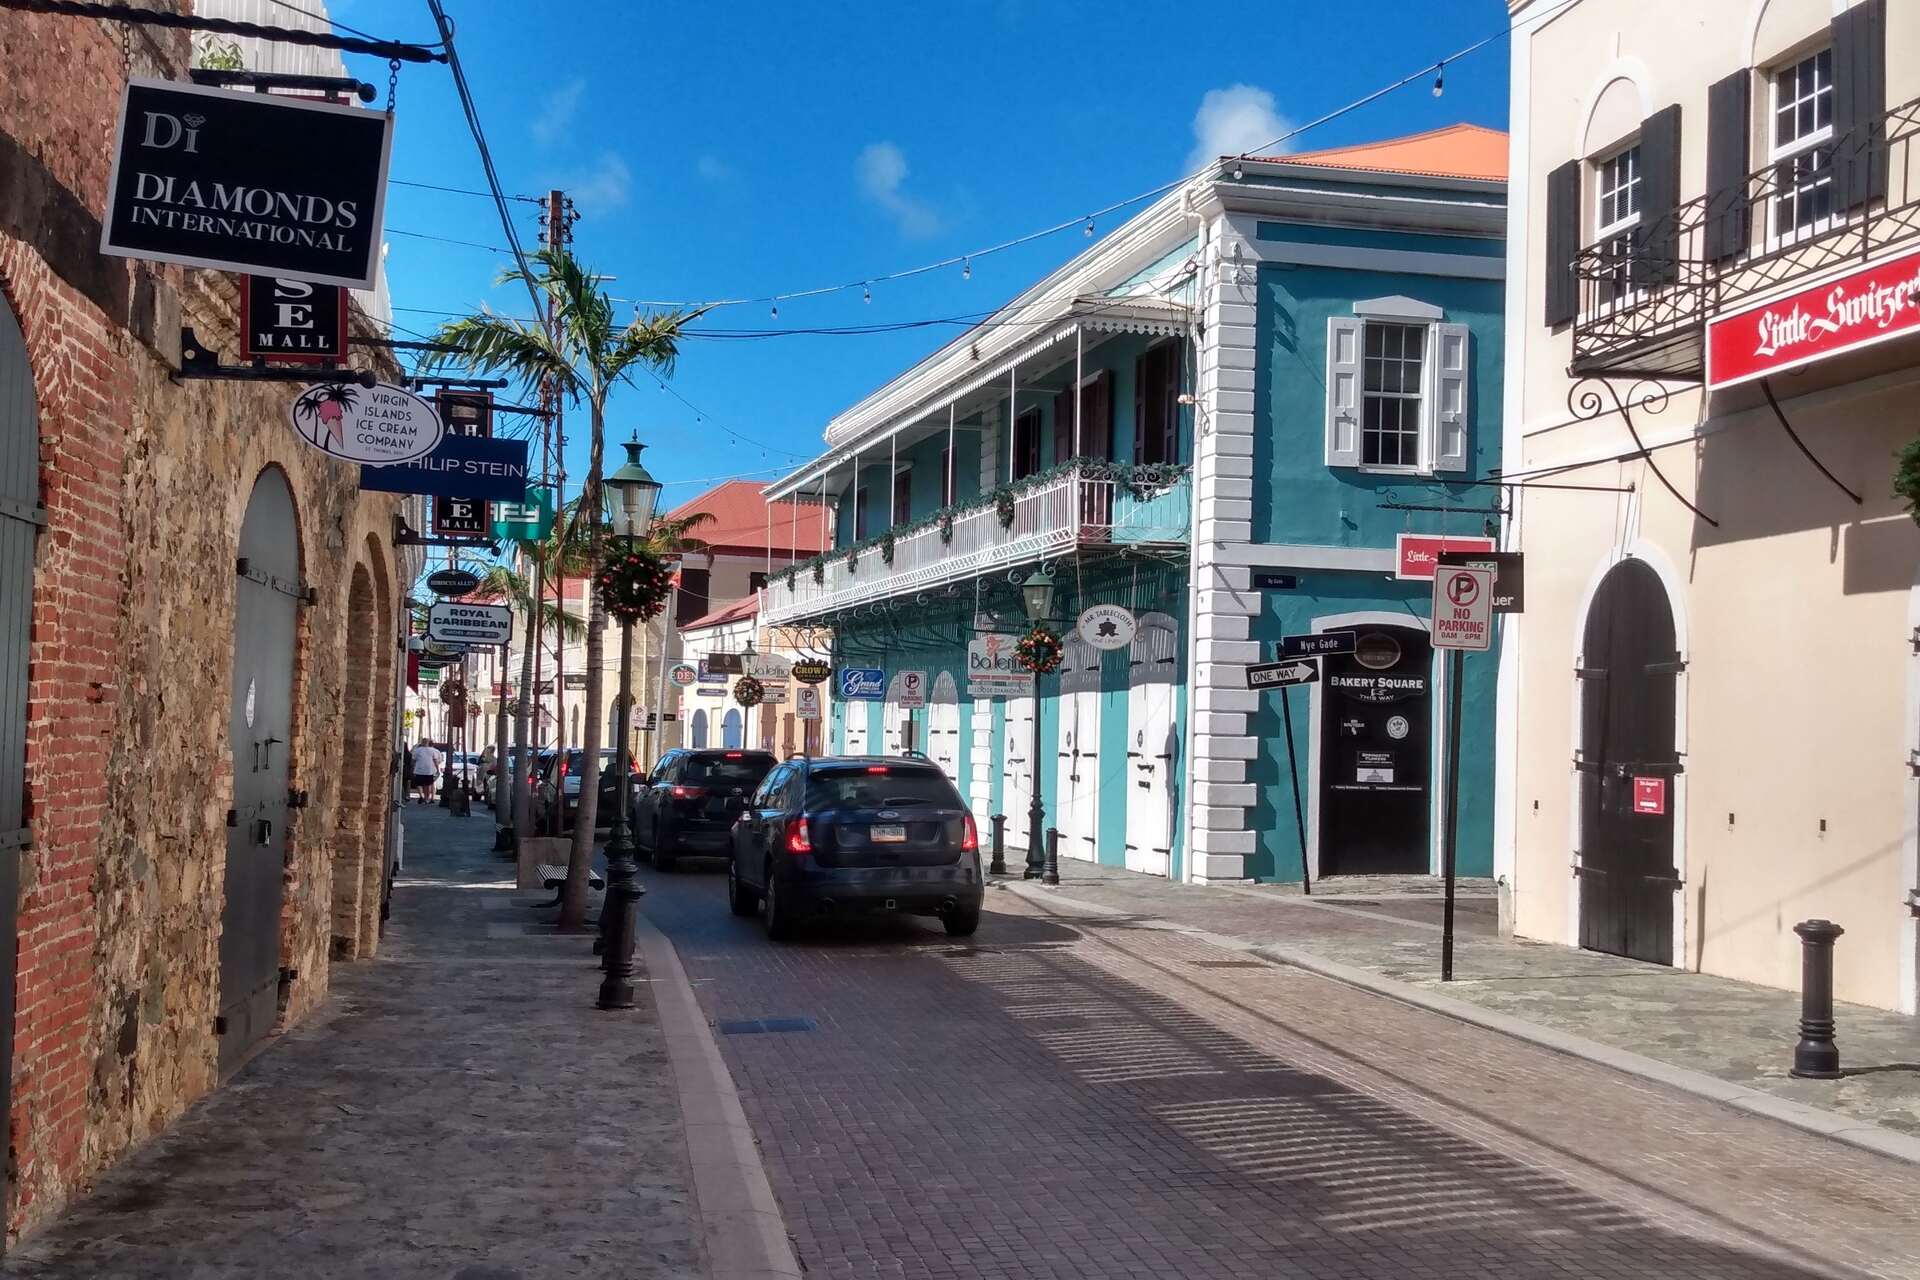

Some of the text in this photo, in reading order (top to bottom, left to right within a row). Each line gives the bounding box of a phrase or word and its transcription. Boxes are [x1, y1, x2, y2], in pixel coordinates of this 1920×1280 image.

[133, 172, 358, 229] DIAMONDS
[131, 206, 353, 252] INTERNATIONAL
[1753, 266, 1920, 357] Little Switzer
[258, 333, 330, 349] MALL
[372, 393, 410, 407] VIRGIN
[364, 406, 412, 421] ISLANDS
[356, 418, 418, 437] ICE CREAM
[356, 433, 415, 450] COMPANY
[394, 457, 524, 478] HILIP STEIN
[441, 519, 481, 530] MALL
[1405, 550, 1430, 563] Little
[1492, 595, 1514, 606] uer
[450, 608, 493, 619] ROYAL
[1453, 608, 1471, 620] NO
[433, 617, 508, 629] CARIBBEAN
[1438, 619, 1485, 633] PARKING
[1300, 638, 1338, 652] Nye Gade
[795, 666, 829, 675] CROWN
[1253, 668, 1296, 683] ONE WAY
[843, 670, 881, 696] Grand
[1330, 676, 1424, 689] BAKERY SQUARE
